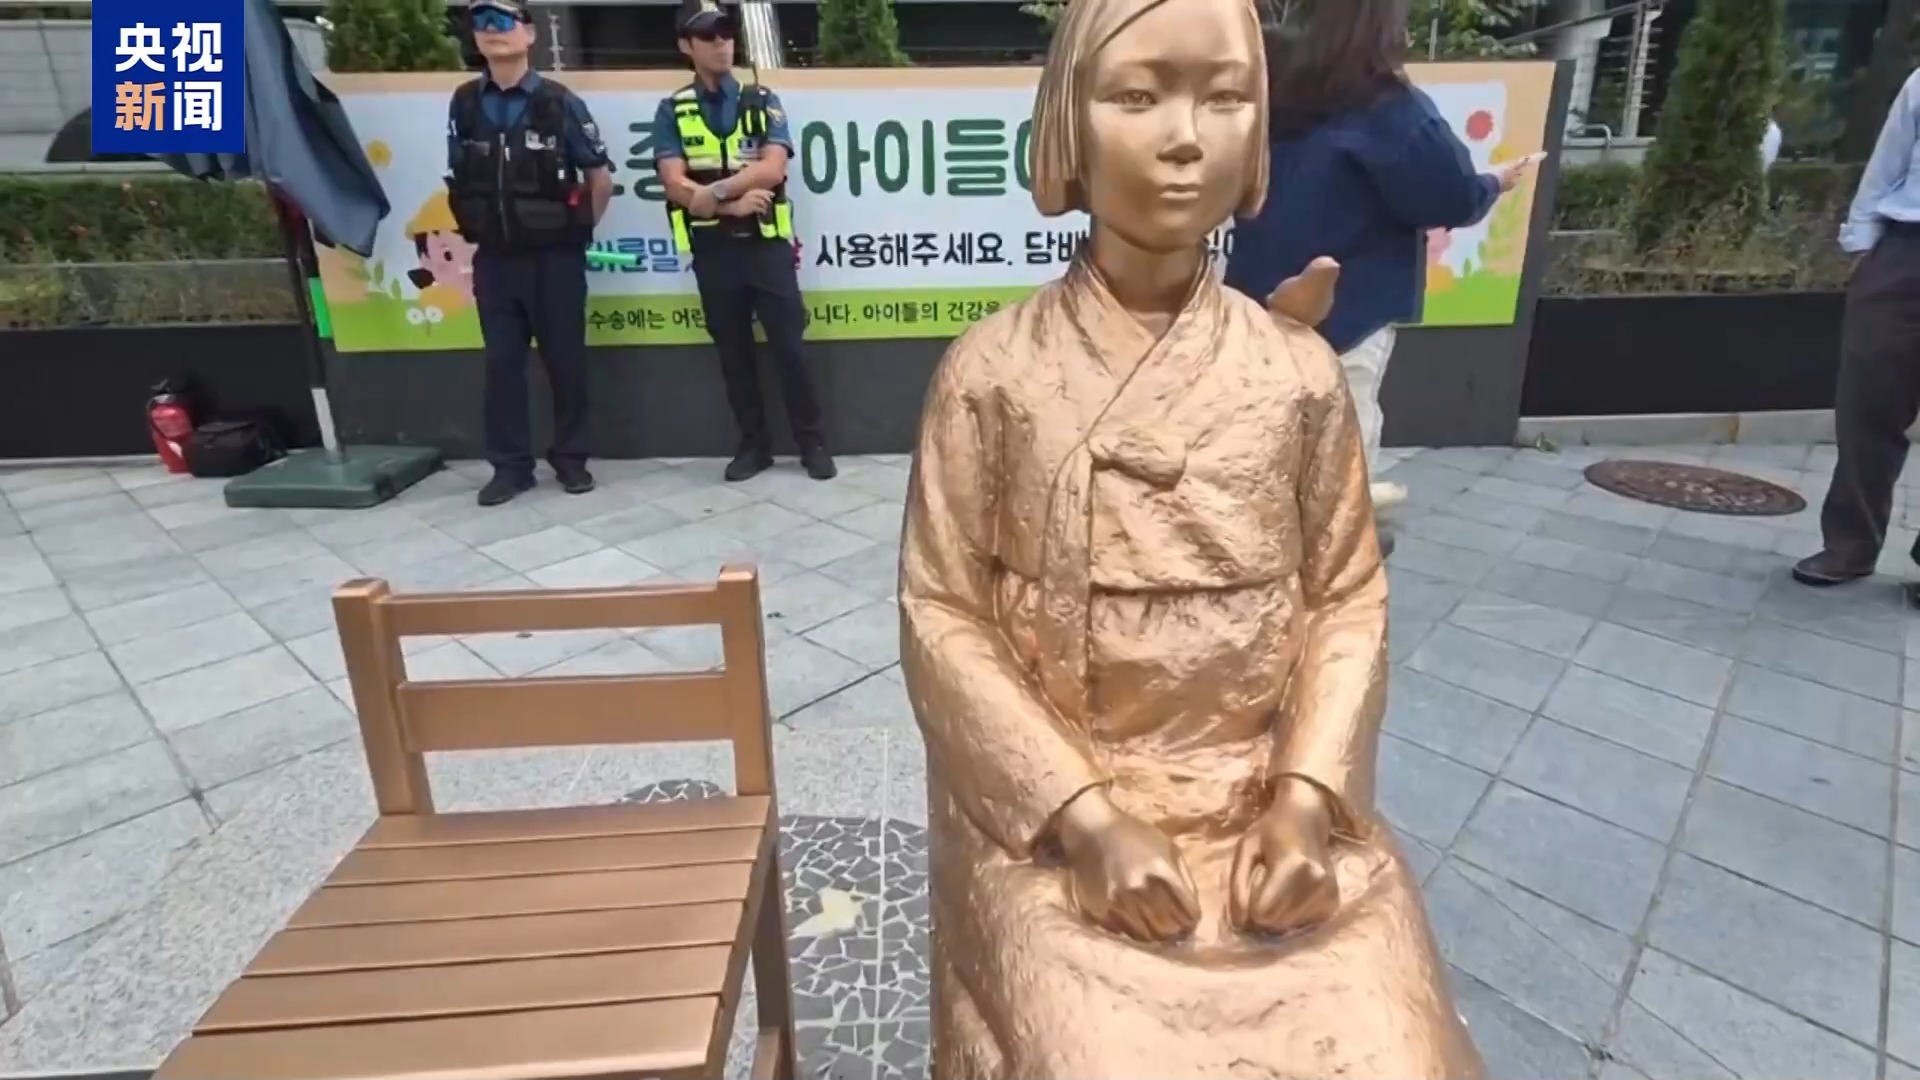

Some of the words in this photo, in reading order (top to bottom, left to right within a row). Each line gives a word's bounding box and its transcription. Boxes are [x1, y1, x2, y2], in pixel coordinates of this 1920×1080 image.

[815, 232, 1013, 269] 사용해주세요.
[803, 302, 858, 325] 니다.
[863, 301, 938, 323] 아이들의
